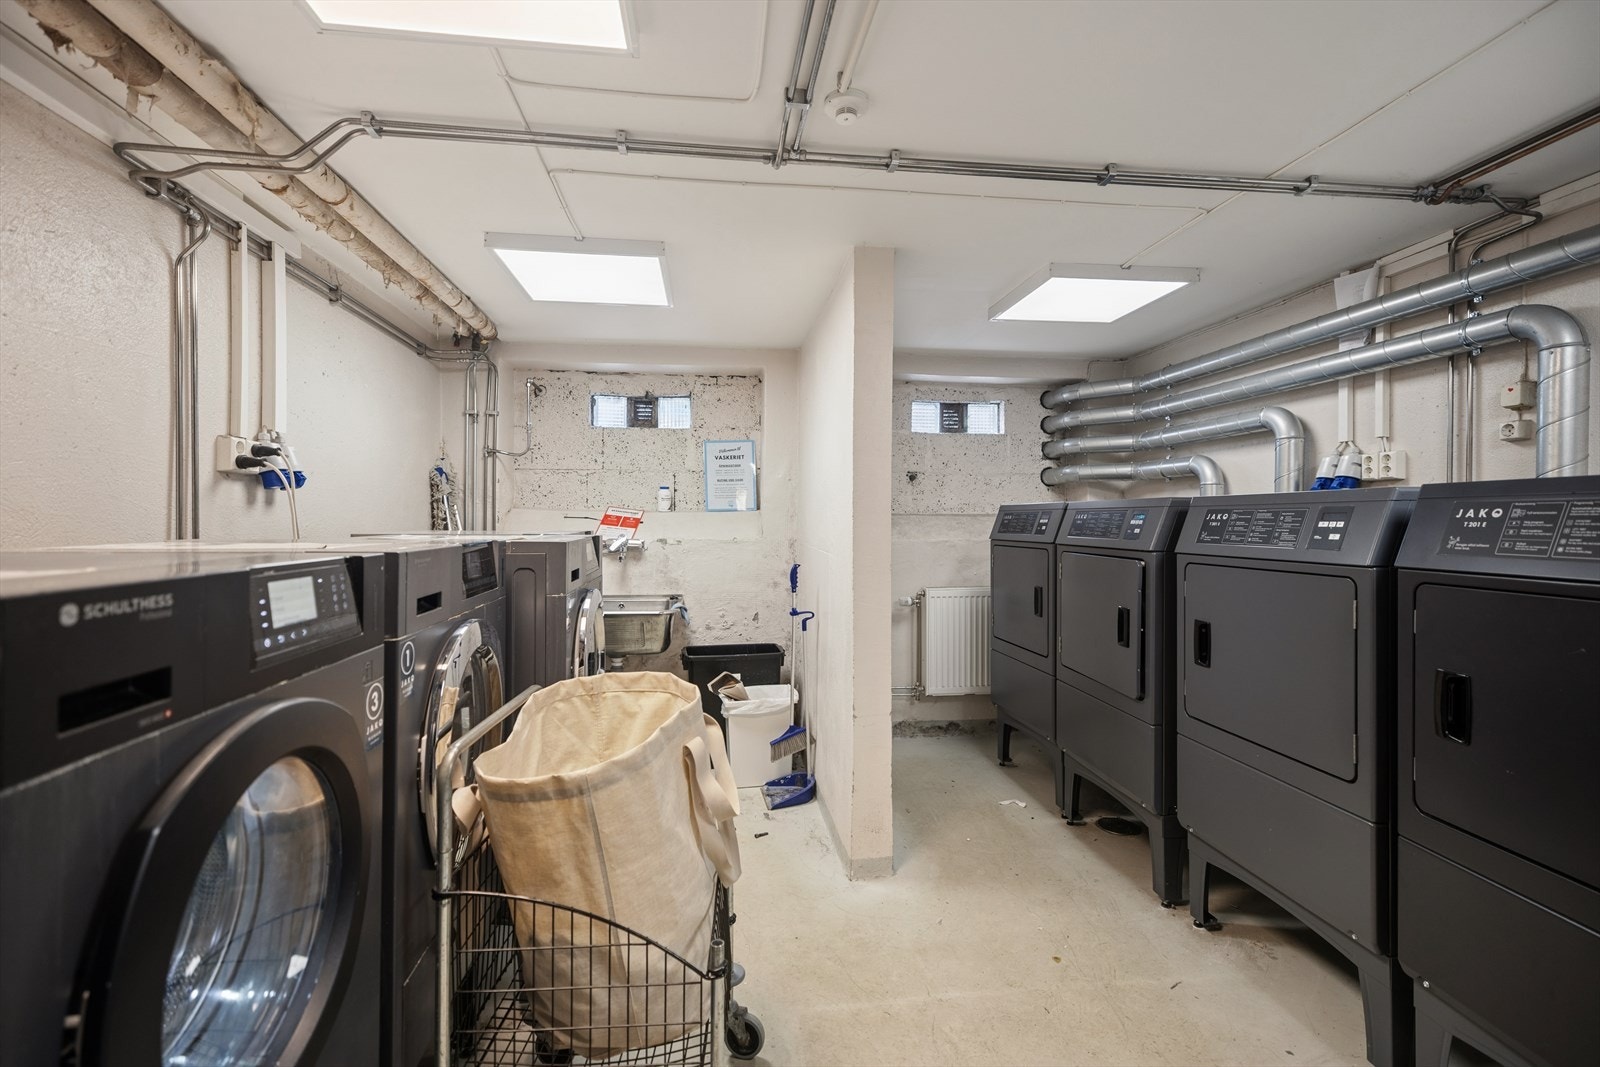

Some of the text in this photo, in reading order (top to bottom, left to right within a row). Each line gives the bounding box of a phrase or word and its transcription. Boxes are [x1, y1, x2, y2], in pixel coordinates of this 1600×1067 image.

[1456, 508, 1503, 518] JAKO
[83, 593, 173, 620] SCHULTHESS
[406, 649, 410, 667] 1
[371, 691, 379, 712] 3
[366, 718, 383, 735] JAKO
